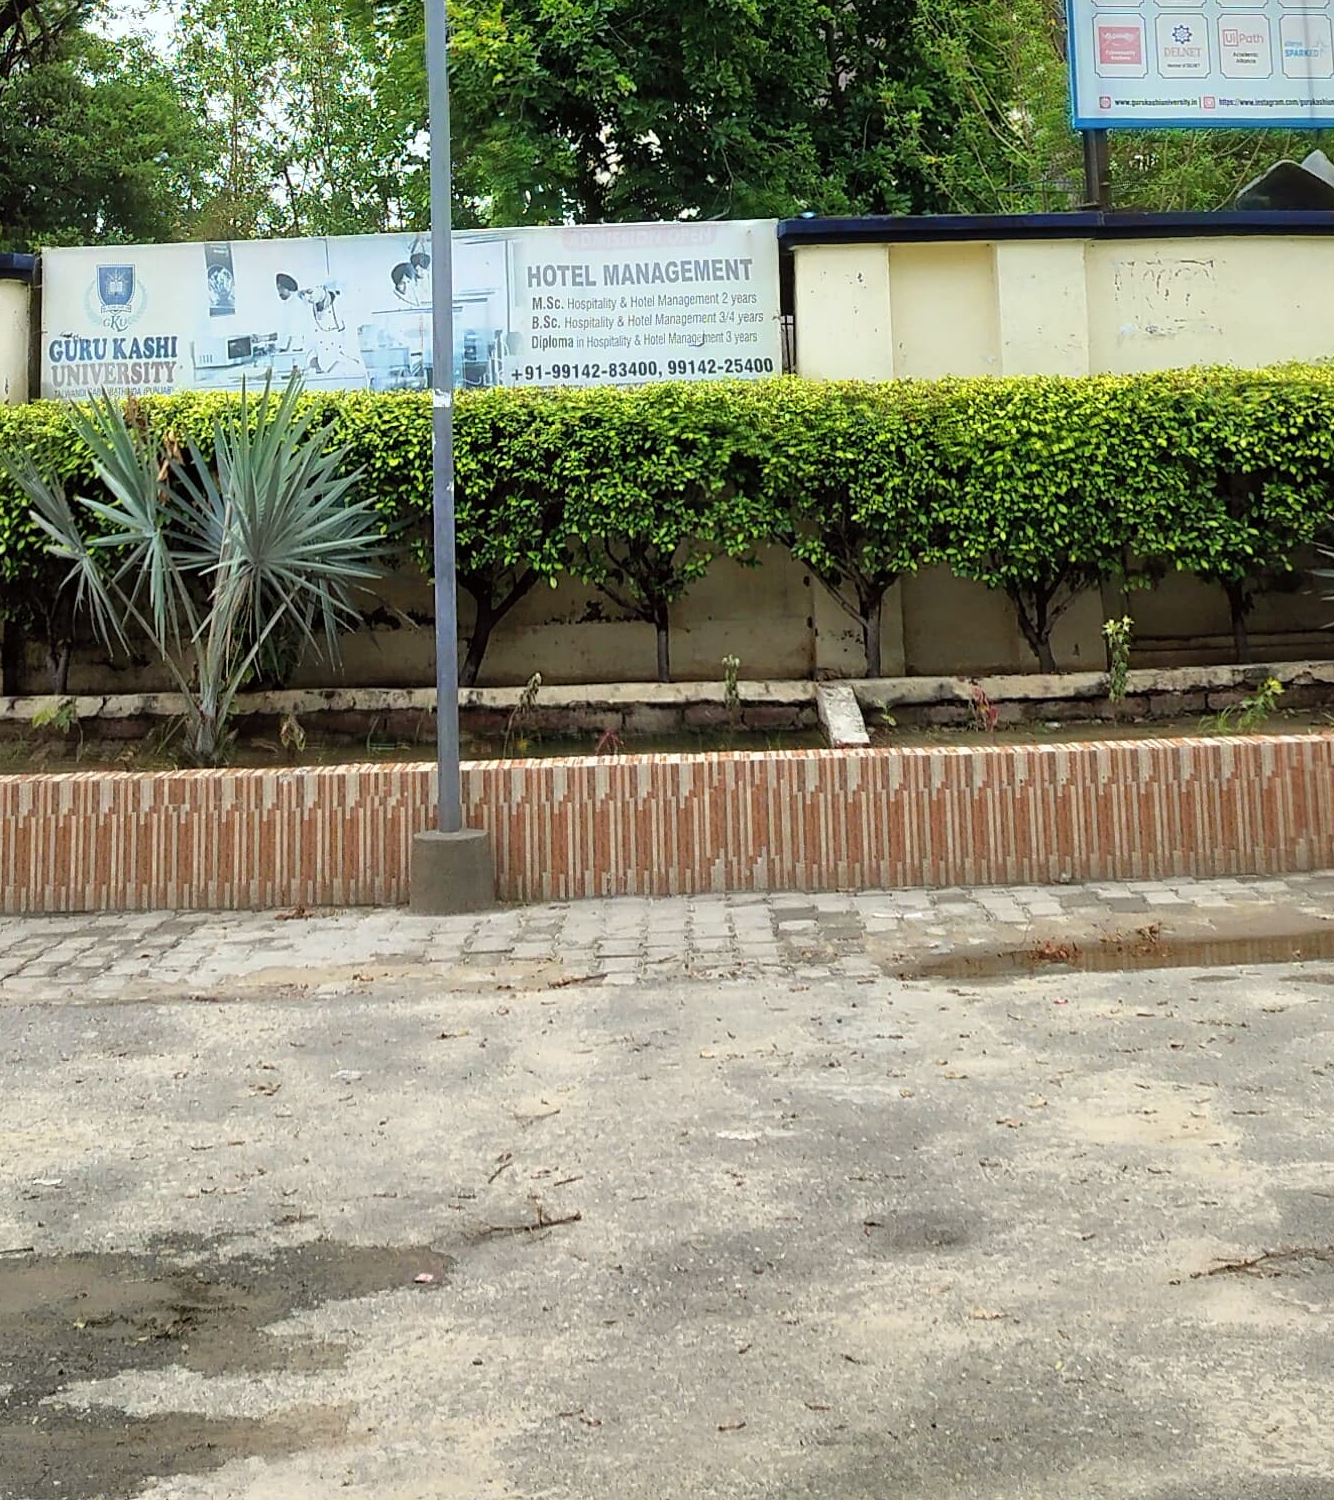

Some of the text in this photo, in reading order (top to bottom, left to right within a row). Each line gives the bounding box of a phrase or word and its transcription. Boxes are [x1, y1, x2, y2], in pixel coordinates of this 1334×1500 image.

[1163, 47, 1202, 58] DELNET
[527, 258, 754, 288] HOTEL MANAGEMENT
[531, 292, 757, 312] M.Sc. Hospitality & Hotel Management 2 years
[531, 310, 764, 331] B.Sc. Hospitality & Hotel Management 3/4 years
[48, 335, 178, 363] GURU KASHI
[531, 330, 758, 351] Diploma in Hospitality & Hotel Management 3 years
[51, 360, 177, 387] UNIVERSITY
[511, 357, 774, 381] +91-99142-83400, 99142-25400
